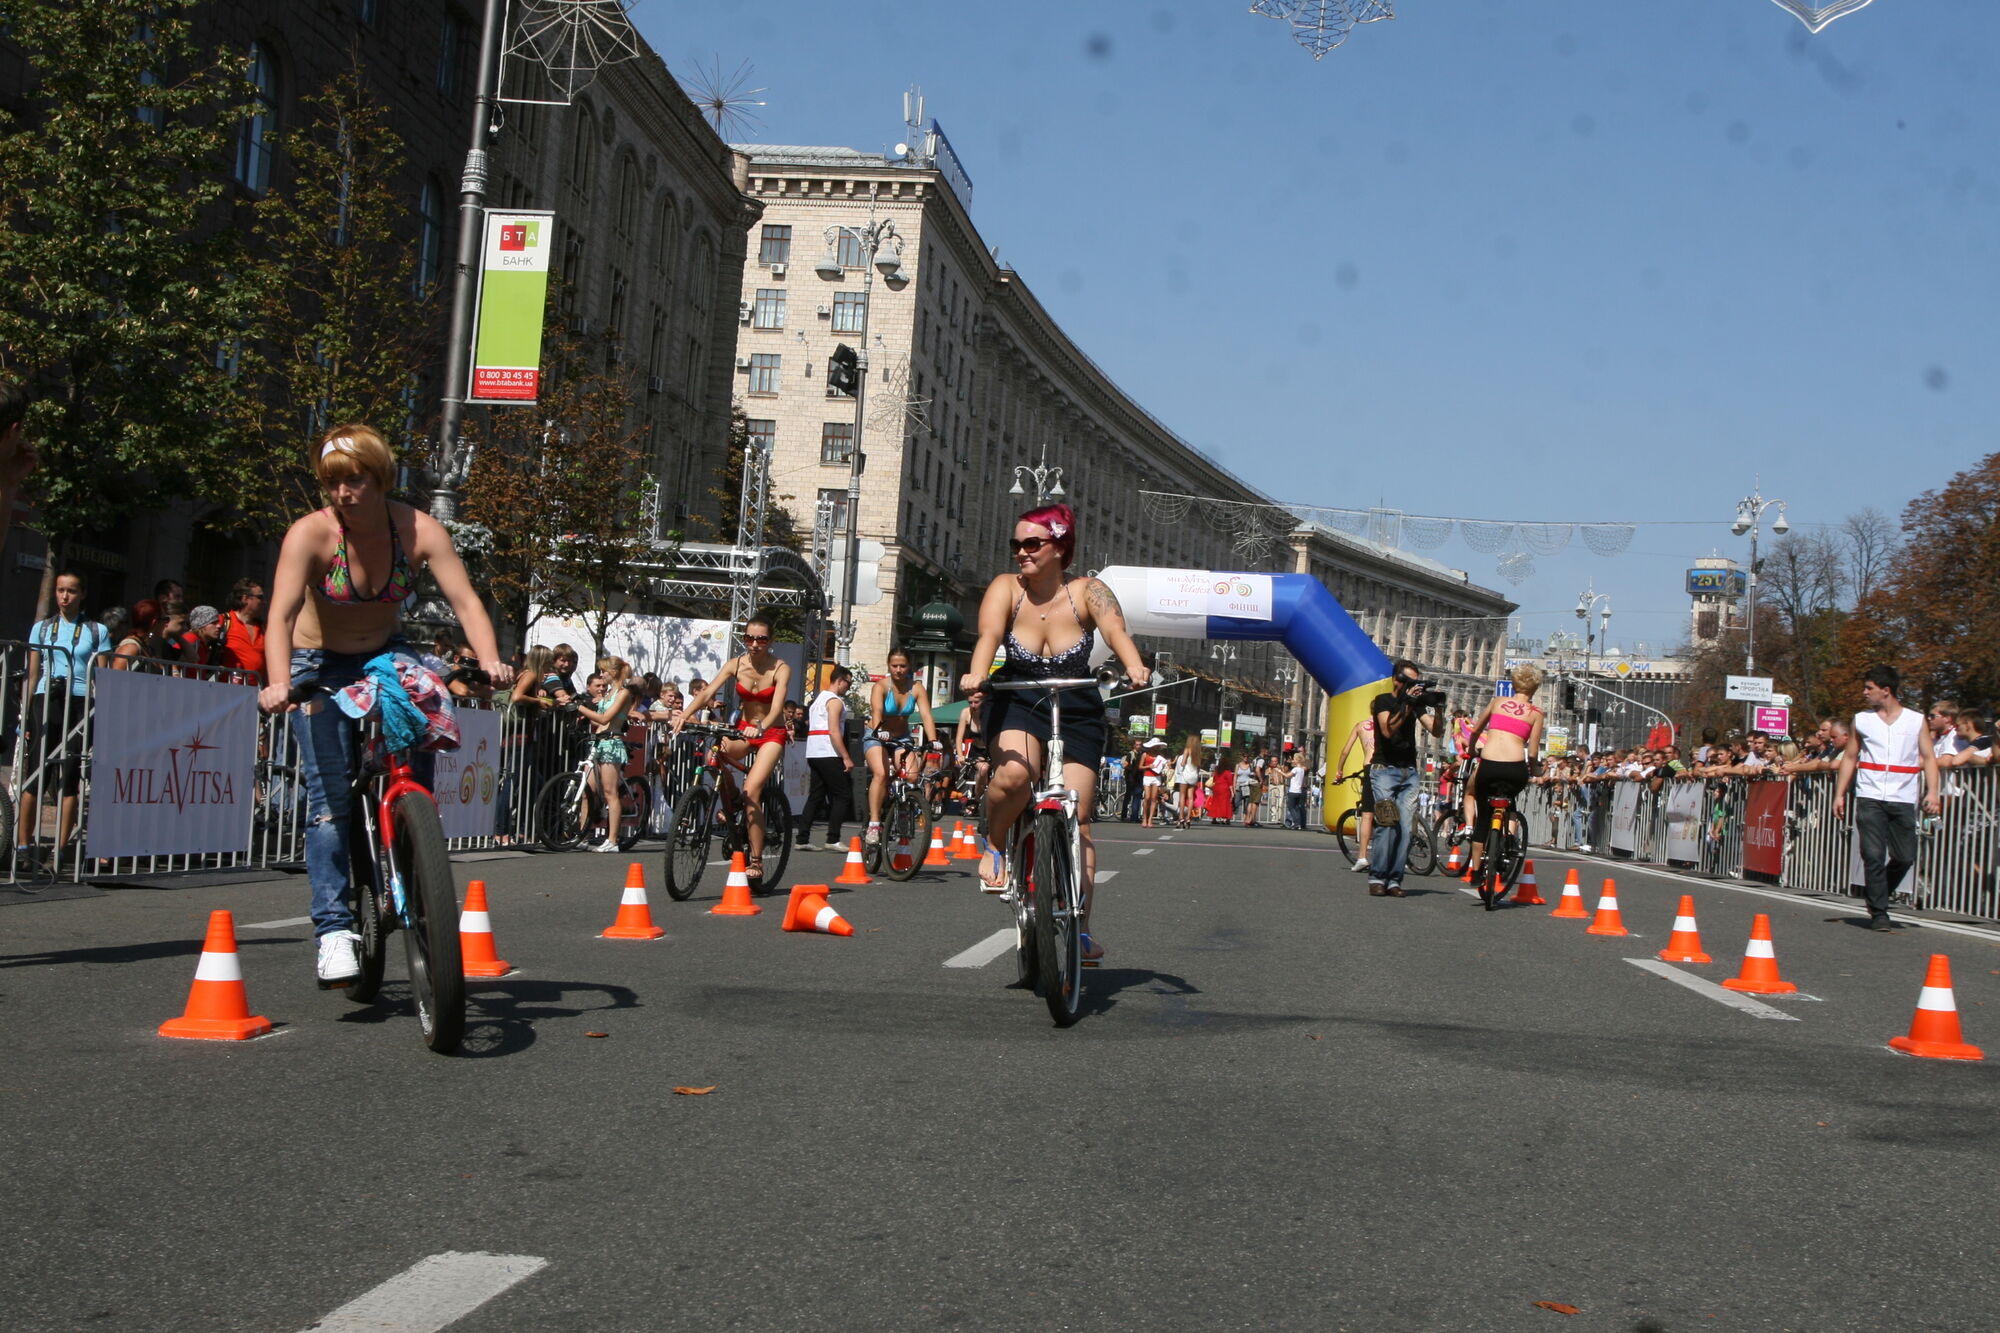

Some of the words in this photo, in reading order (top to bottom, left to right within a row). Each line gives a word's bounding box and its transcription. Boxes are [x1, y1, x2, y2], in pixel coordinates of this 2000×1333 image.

[503, 231, 537, 242] БТА
[502, 256, 534, 266] БАНК
[480, 371, 485, 379] 0
[486, 371, 500, 379] 800
[502, 371, 512, 380] 30
[512, 372, 522, 380] 45
[524, 372, 534, 380] 45
[1179, 584, 1211, 594] Velofest
[1160, 599, 1189, 608] СТАРТ
[1501, 700, 1524, 716] 28
[112, 748, 235, 815] MILAVITSA
